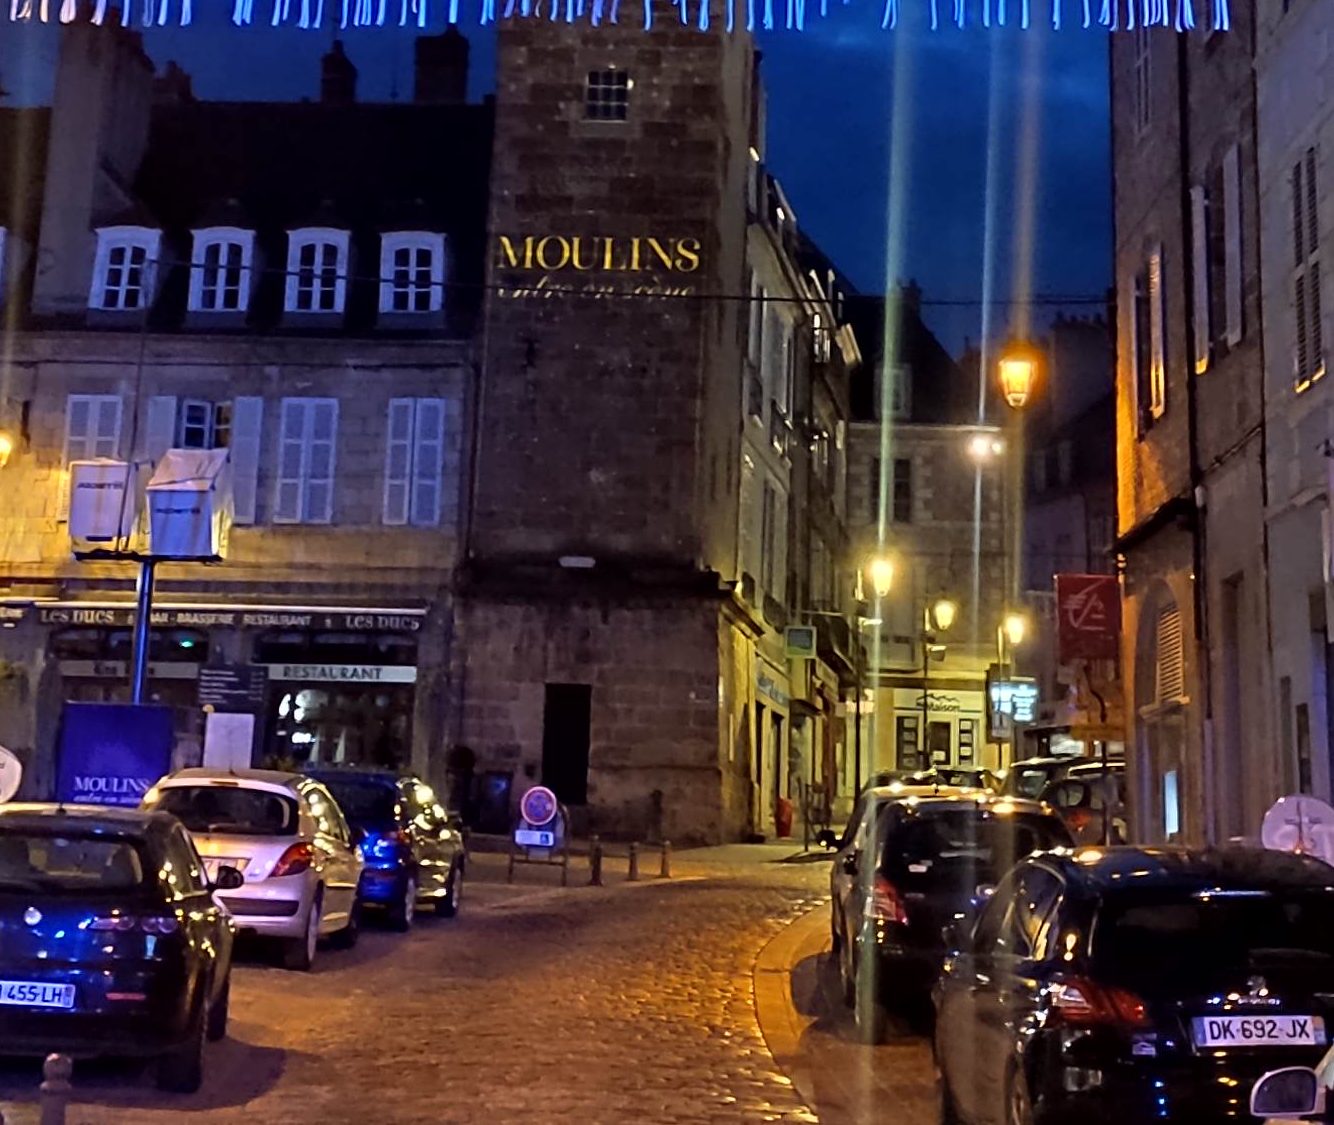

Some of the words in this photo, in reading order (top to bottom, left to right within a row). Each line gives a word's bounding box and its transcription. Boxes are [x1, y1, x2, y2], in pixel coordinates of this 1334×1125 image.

[496, 234, 702, 273] MOULINS
[243, 614, 312, 626] RESTAURANT
[282, 665, 384, 681] RESTAURANT
